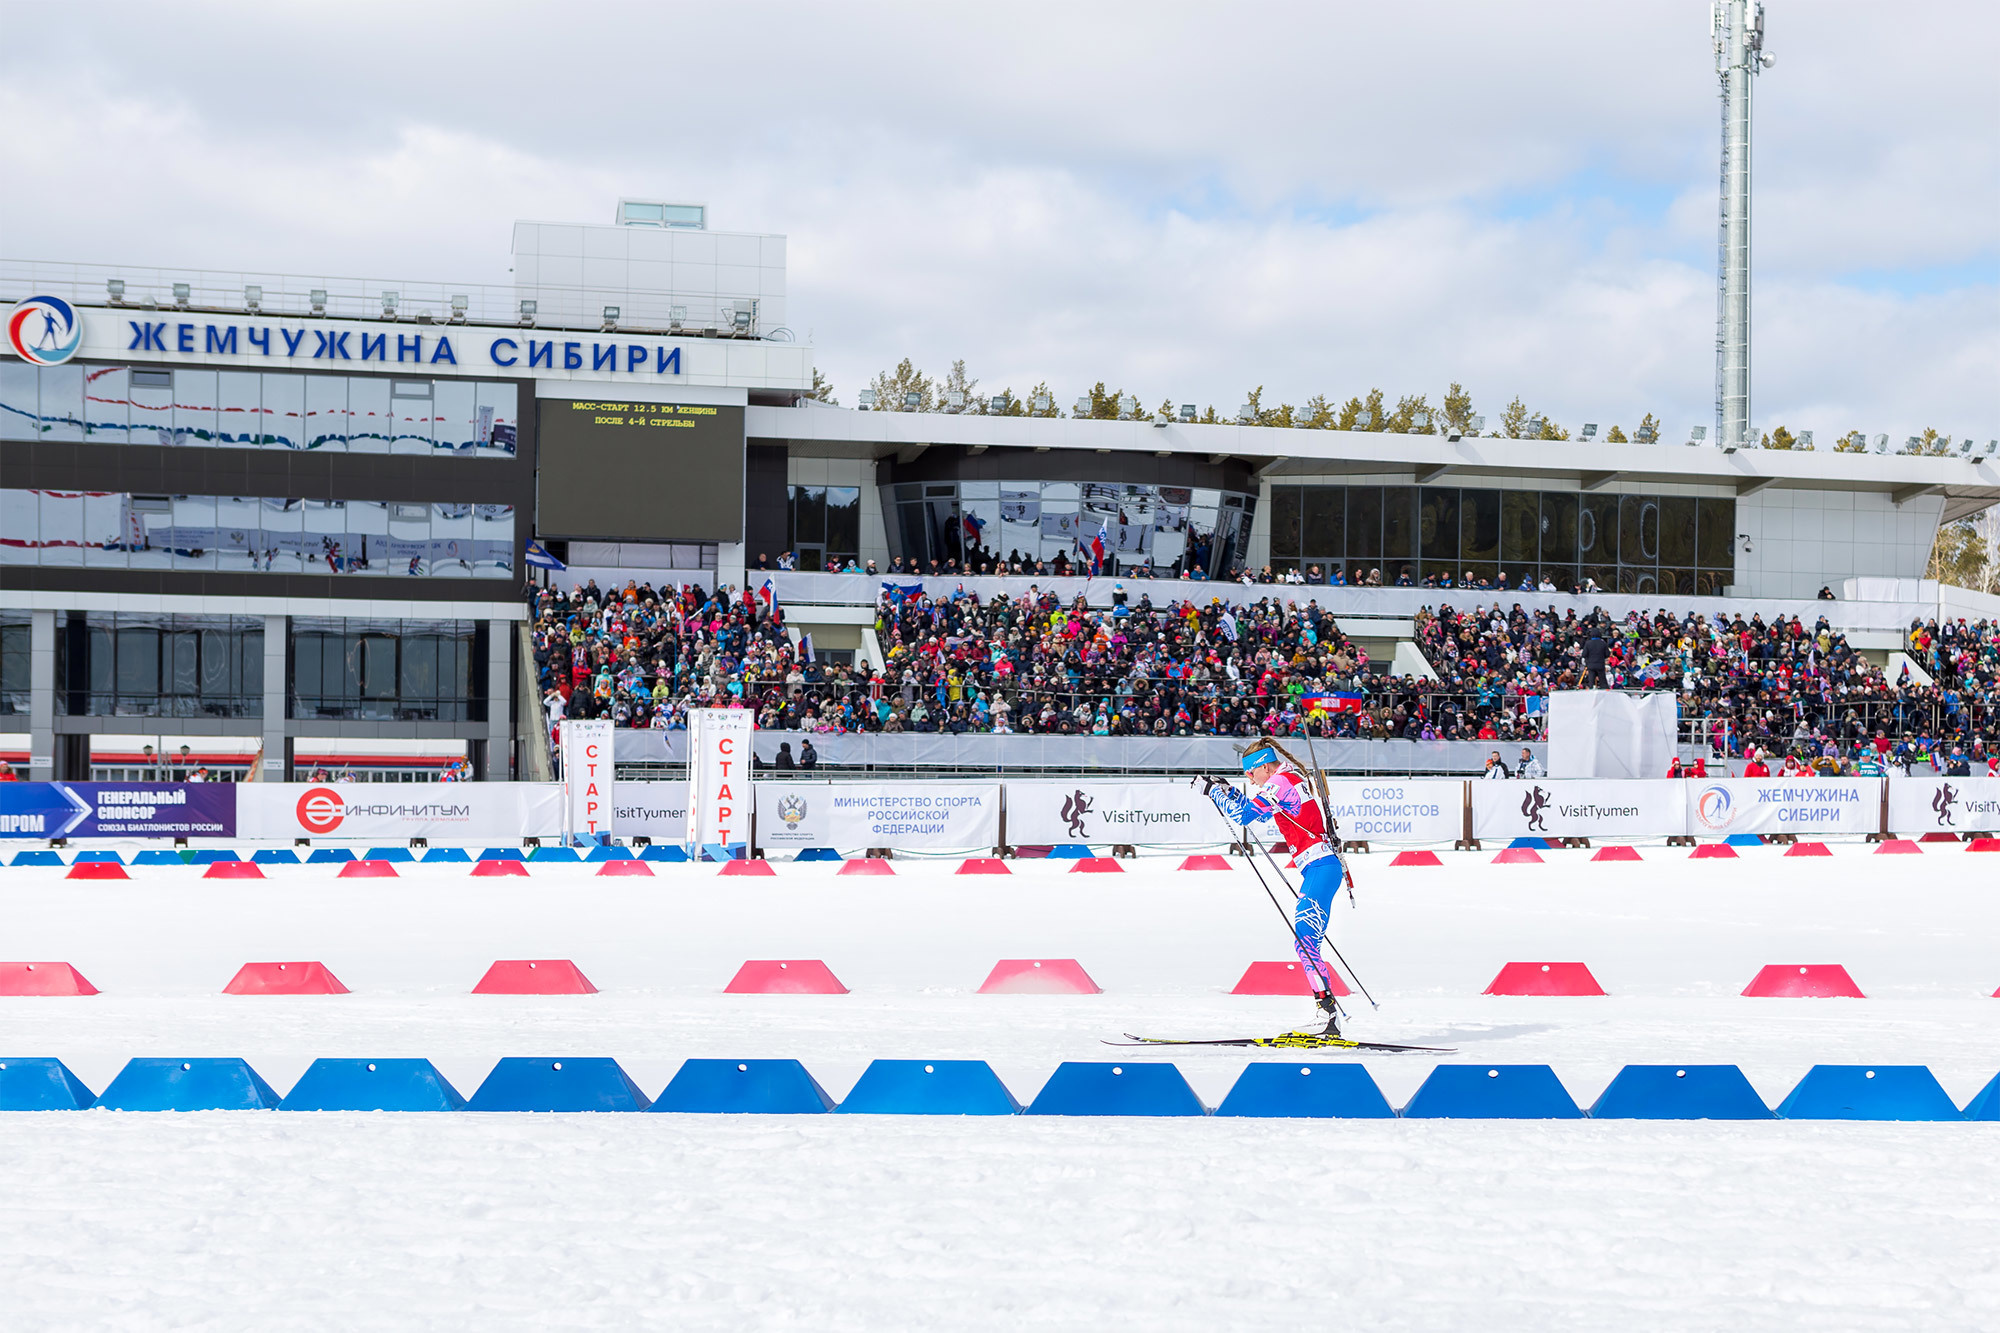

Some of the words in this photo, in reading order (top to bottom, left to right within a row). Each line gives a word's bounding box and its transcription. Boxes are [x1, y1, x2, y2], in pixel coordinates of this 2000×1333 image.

[128, 321, 457, 365] ЖЕМЧУЖИНА
[490, 337, 680, 375] СИБИРИ
[572, 402, 629, 412] МАСС-СТАРТ
[634, 405, 656, 413] 12.5
[595, 416, 623, 425] ПОСЛЕ
[628, 417, 645, 426] 4-Й
[650, 419, 695, 428] СТРЕЛЬБЫ
[97, 789, 186, 804] ГЕНЕРАЛЬНЫЙ
[586, 745, 598, 834] СТАРТ
[717, 738, 733, 846] СТАРТ
[1362, 788, 1404, 799] СОЮЗ
[1757, 788, 1860, 802] ЖЕМЧУЖИНА
[834, 797, 932, 807] МИНИСТЕРСТВО
[935, 796, 982, 807] СПОРТА
[97, 806, 156, 820] СПОНСОР
[346, 804, 469, 816] ИНФИНИТУМ
[614, 807, 686, 821] isitTyumen
[867, 809, 949, 820] РОССИЙСКОЙ
[1559, 804, 1639, 819] VisitTyumen
[1777, 808, 1840, 822] СИБИРИ
[1102, 810, 1190, 826] VisitTyumen
[97, 824, 126, 832] СОЮЗА
[127, 824, 190, 832] БИАТЛОНИСТОВ
[191, 824, 223, 832] РОССИИ
[872, 824, 944, 834] ФЕДЕРАЦИИ
[1354, 822, 1412, 833] РОССИИ
